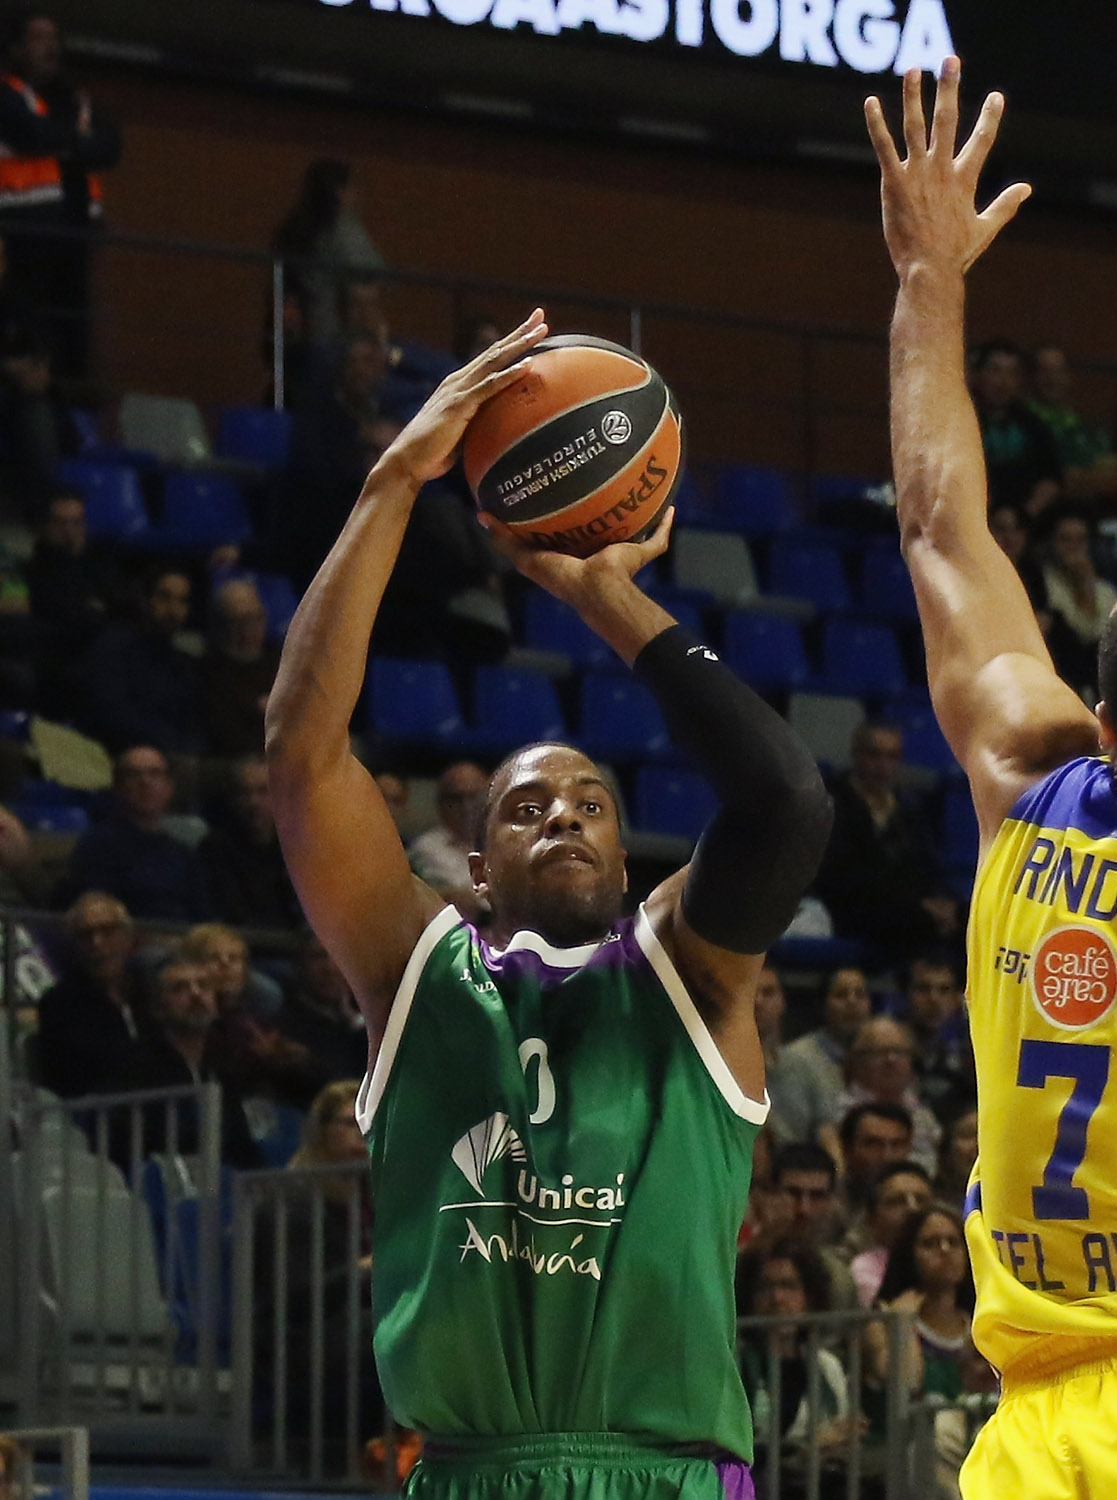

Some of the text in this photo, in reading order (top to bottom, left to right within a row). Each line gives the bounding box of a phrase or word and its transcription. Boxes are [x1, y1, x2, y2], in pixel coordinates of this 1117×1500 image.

[548, 441, 608, 484] TURKISH
[1044, 946, 1109, 979] café
[1042, 975, 1108, 1008] café
[1016, 1038, 1112, 1221] 7
[991, 1229, 1066, 1291] TEL
